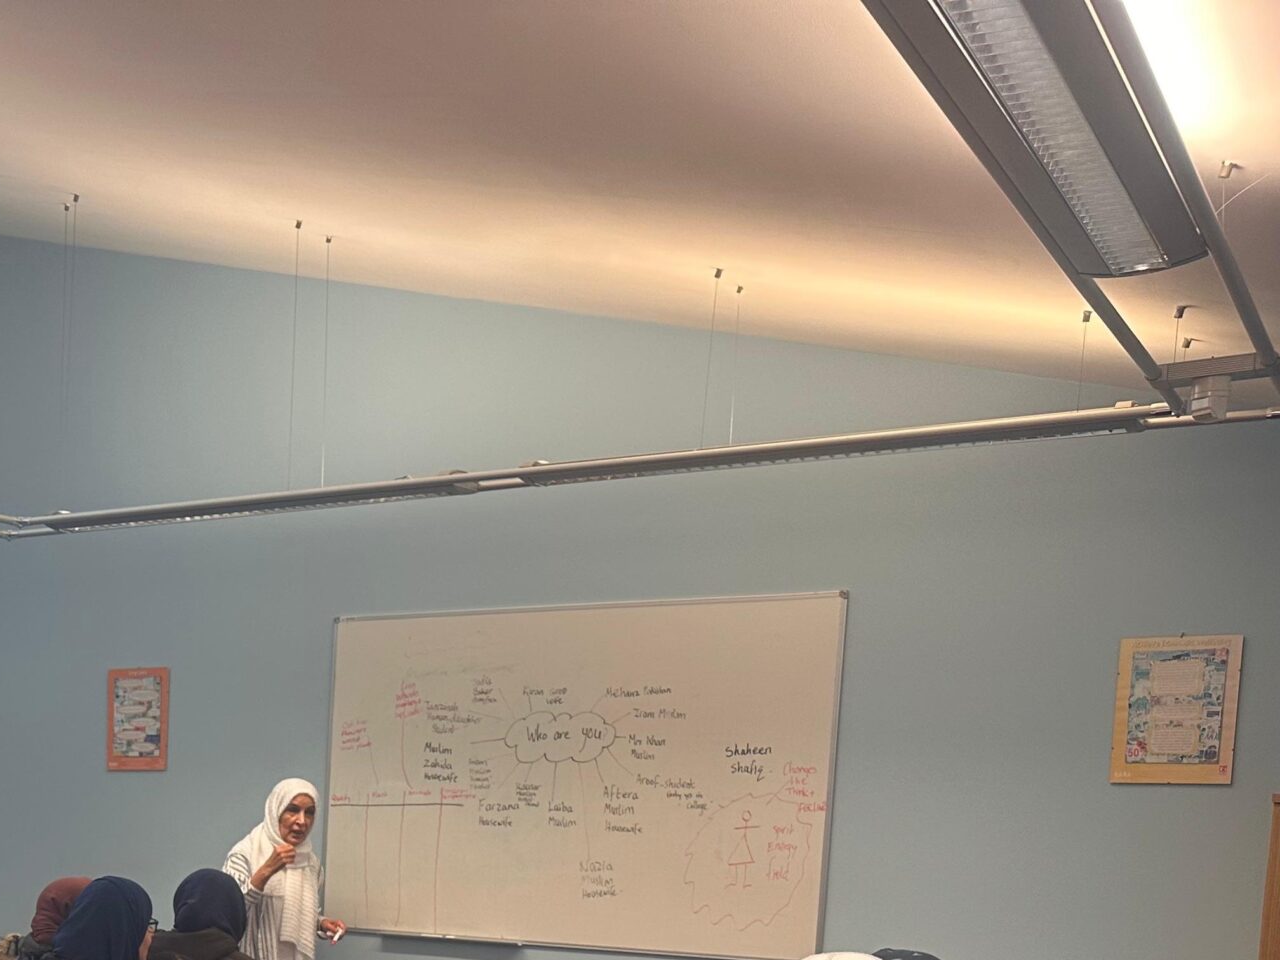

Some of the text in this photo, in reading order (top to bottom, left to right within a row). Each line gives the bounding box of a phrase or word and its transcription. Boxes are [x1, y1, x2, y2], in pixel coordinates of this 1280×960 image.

[526, 723, 549, 742] Who
[553, 730, 571, 741] are
[724, 743, 772, 758] Shaheen
[423, 758, 453, 770] Zahida
[478, 798, 520, 812] Farzana
[548, 801, 574, 814] Laiba
